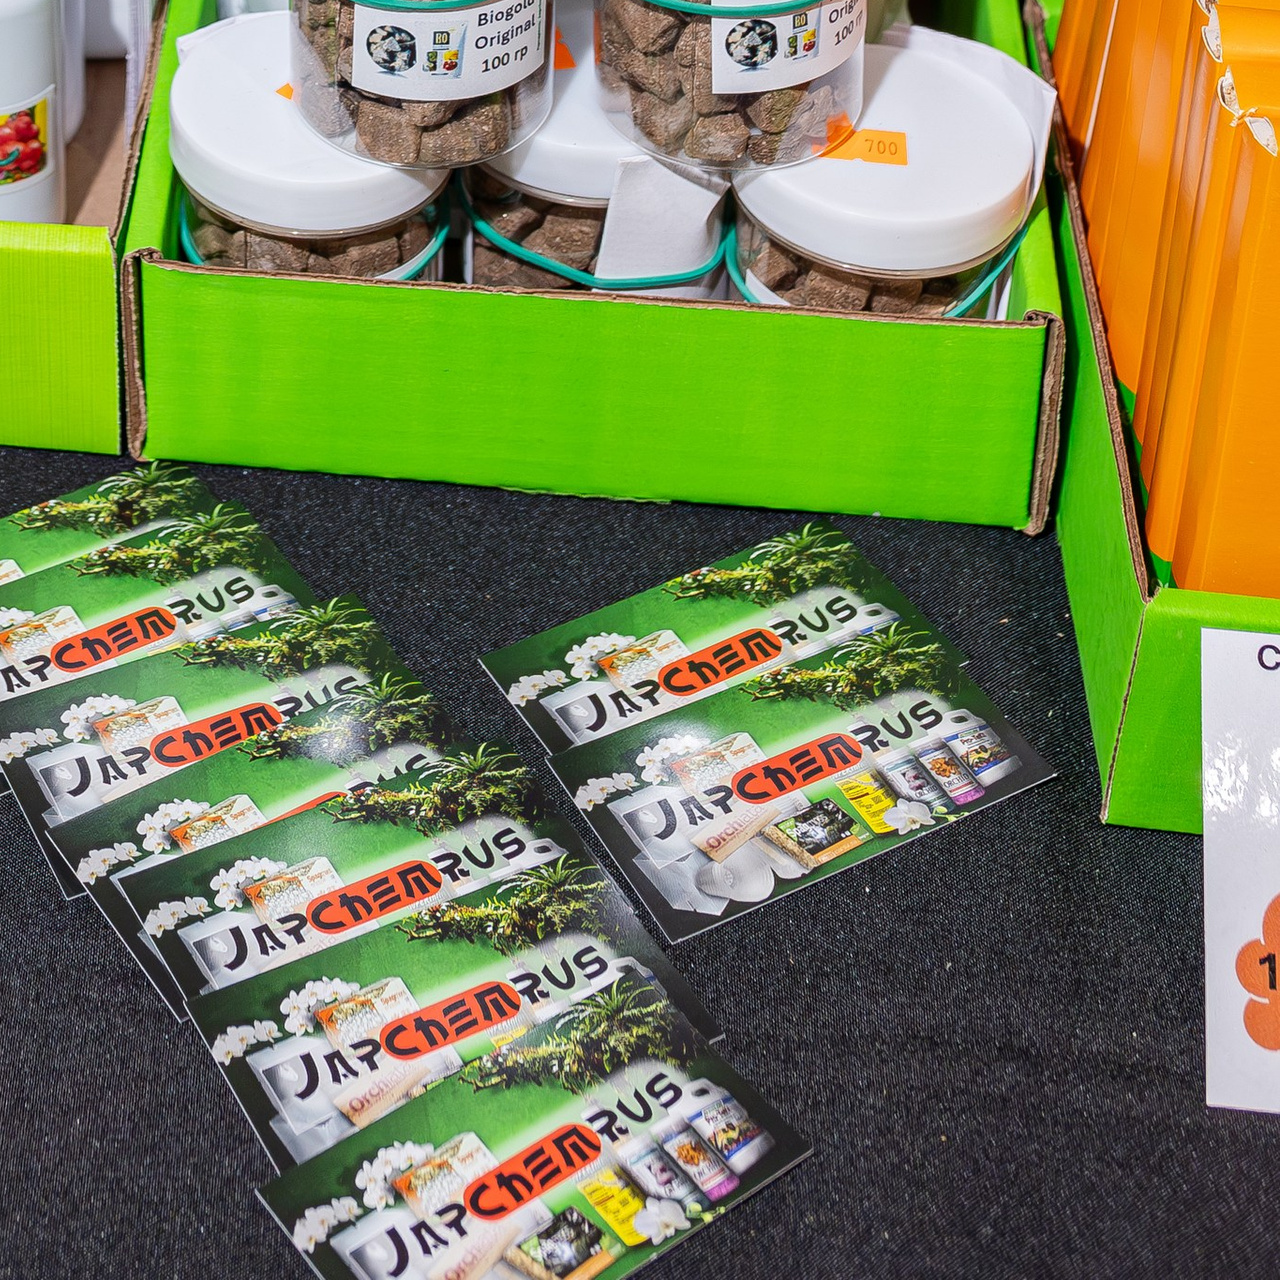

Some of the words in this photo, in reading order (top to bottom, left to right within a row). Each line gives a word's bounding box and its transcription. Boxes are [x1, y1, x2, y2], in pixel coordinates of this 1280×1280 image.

[474, 14, 536, 51] Original
[834, 20, 854, 46] 100
[481, 52, 512, 73] 100
[514, 45, 529, 62] гр
[865, 138, 898, 156] 700
